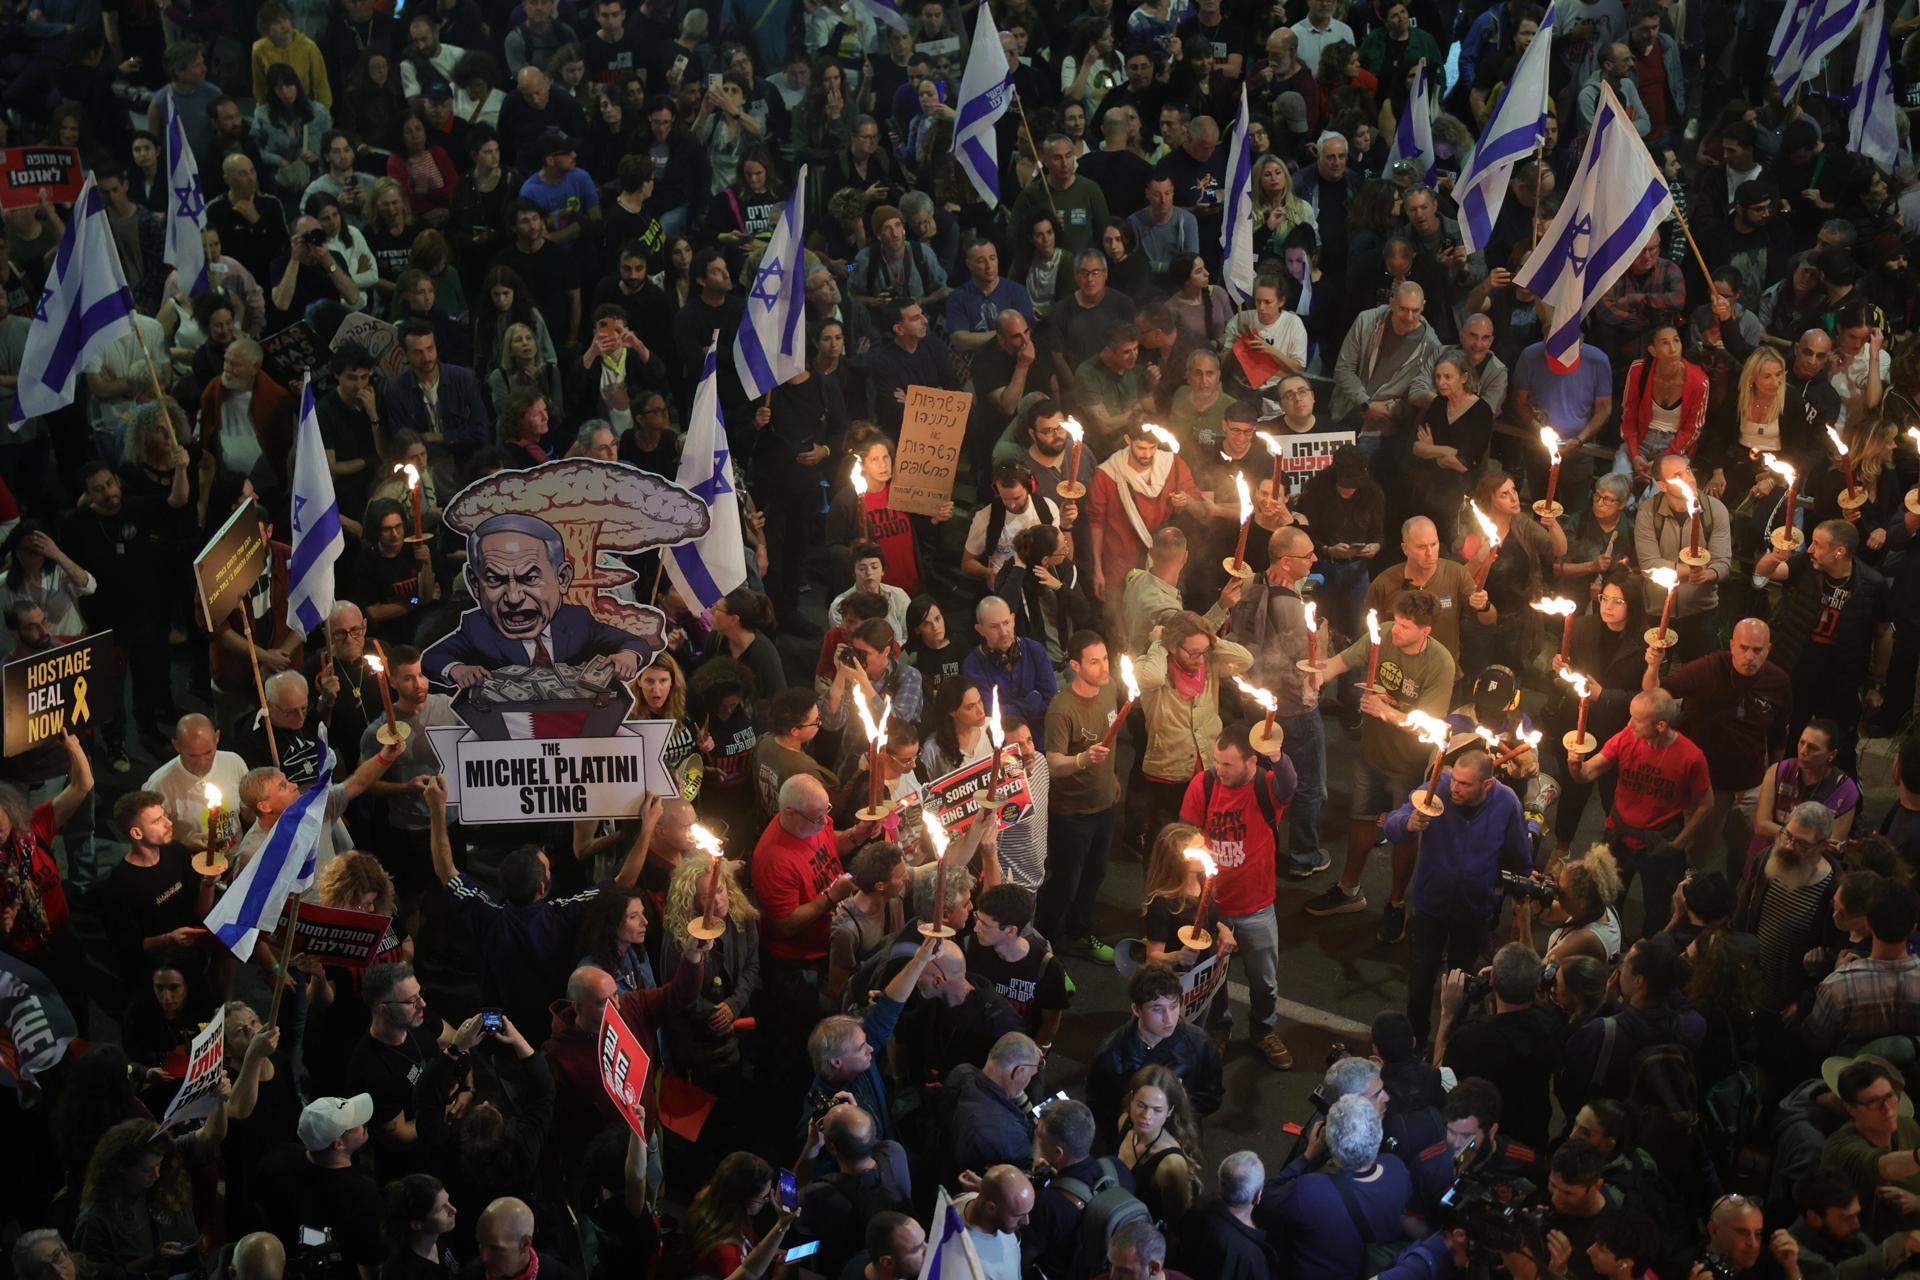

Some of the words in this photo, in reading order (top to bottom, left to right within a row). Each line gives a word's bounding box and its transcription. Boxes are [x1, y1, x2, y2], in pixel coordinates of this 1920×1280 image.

[10, 167, 61, 186] לאונס!
[914, 411, 957, 427] נתניהו
[899, 460, 950, 478] החטופים
[28, 648, 92, 689] HOSTAGE
[28, 683, 65, 715] DEAL
[28, 708, 65, 743] NOW
[541, 743, 560, 756] THE
[466, 757, 550, 787] MICHEL
[554, 755, 638, 784] PLATINI
[520, 785, 588, 814] STING
[945, 778, 979, 803] SORRY
[940, 806, 964, 826] EING
[307, 937, 369, 957] תחילה!
